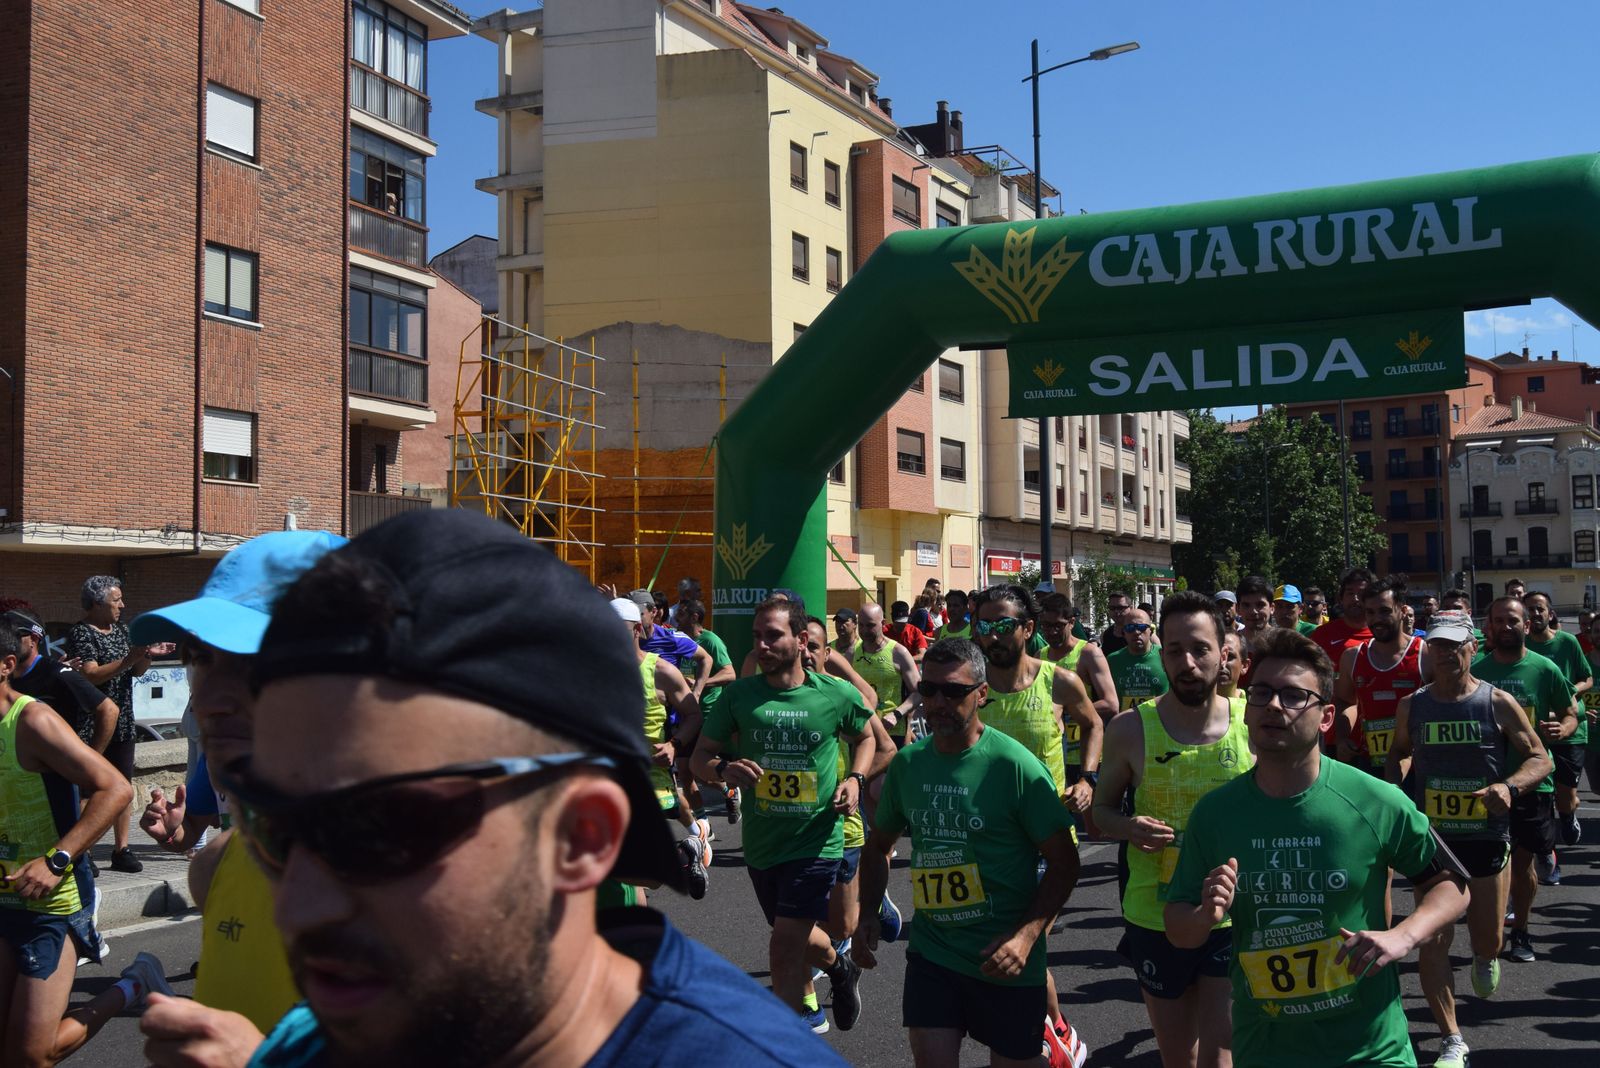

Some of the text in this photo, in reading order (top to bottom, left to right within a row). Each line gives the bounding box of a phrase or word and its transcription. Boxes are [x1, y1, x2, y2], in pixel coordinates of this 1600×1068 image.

[1088, 196, 1503, 287] CAJA RURAL
[1087, 337, 1369, 397] SALIDA
[1383, 361, 1447, 376] CAJA RURAL
[1023, 388, 1077, 400] CAJA RURAL
[1426, 724, 1430, 742] I
[1438, 722, 1480, 742] RUN
[777, 743, 808, 751] ZAMORA
[1371, 733, 1388, 752] 17
[768, 774, 800, 798] 33
[1432, 793, 1476, 816] 197
[1252, 836, 1321, 849] VII CARRERA
[917, 870, 970, 905] 178
[1254, 892, 1325, 904] DE ZAMORA
[932, 908, 985, 922] CAJA RURAL
[1264, 920, 1325, 938] FUNDACION
[1265, 930, 1326, 948] CAJA RURAL
[1266, 949, 1319, 993] 87
[1283, 995, 1354, 1016] CAJA RURAL
